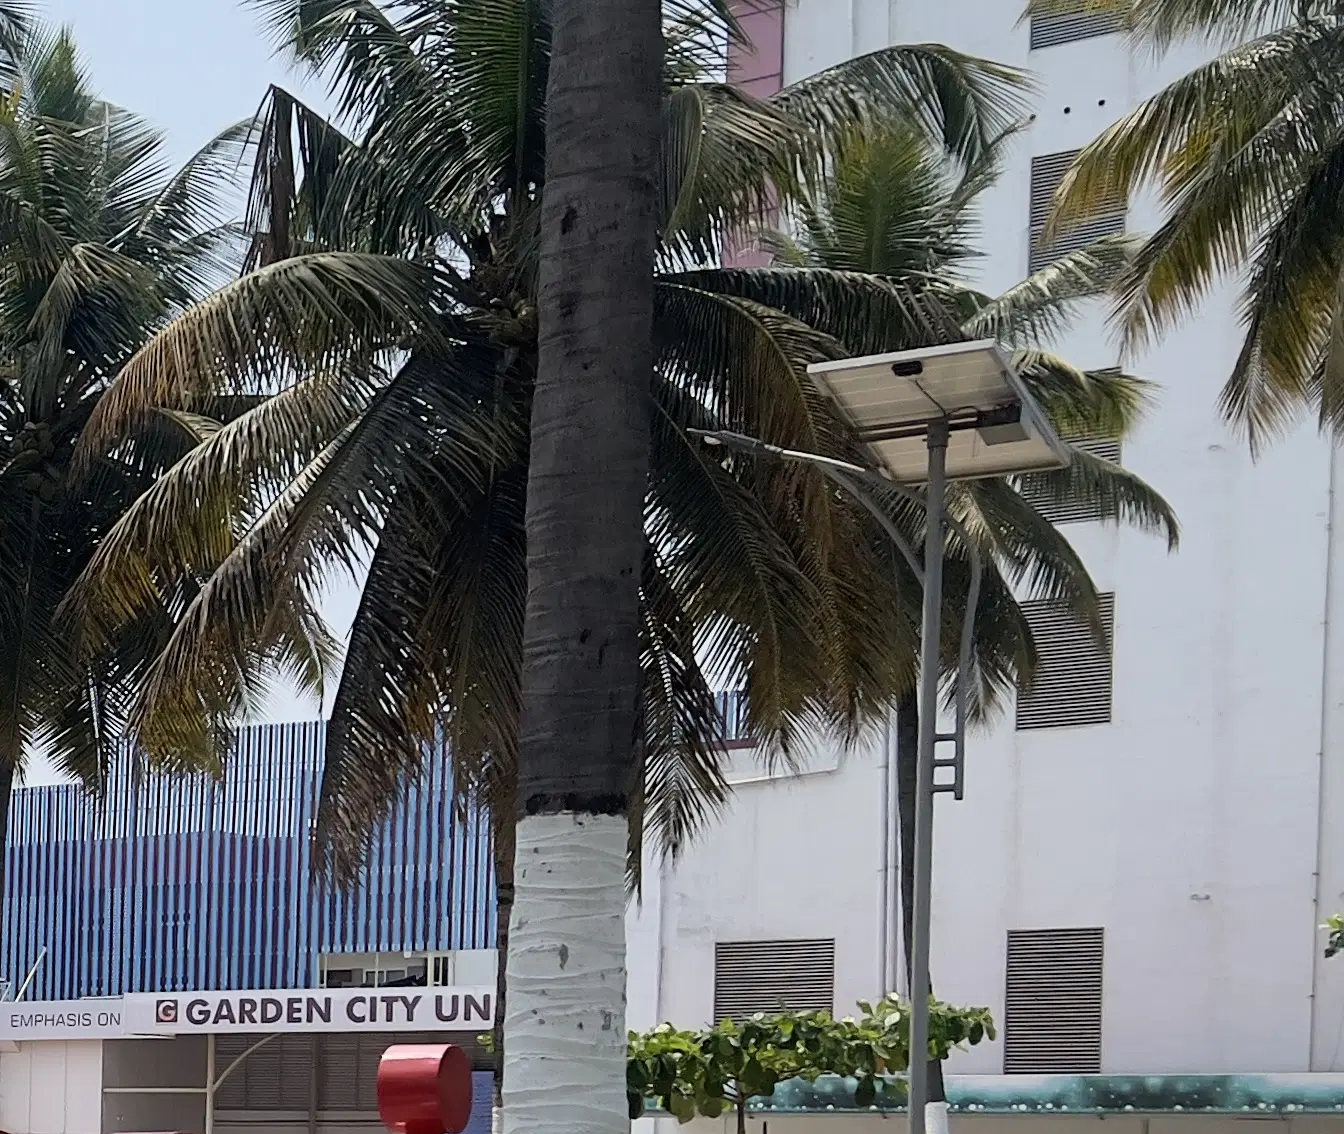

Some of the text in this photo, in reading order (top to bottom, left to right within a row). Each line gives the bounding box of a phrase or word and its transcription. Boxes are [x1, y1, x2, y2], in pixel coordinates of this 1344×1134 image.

[10, 1012, 121, 1028] EMPHASIS ON
[185, 997, 332, 1025] GARDEN
[345, 995, 423, 1023] CITY
